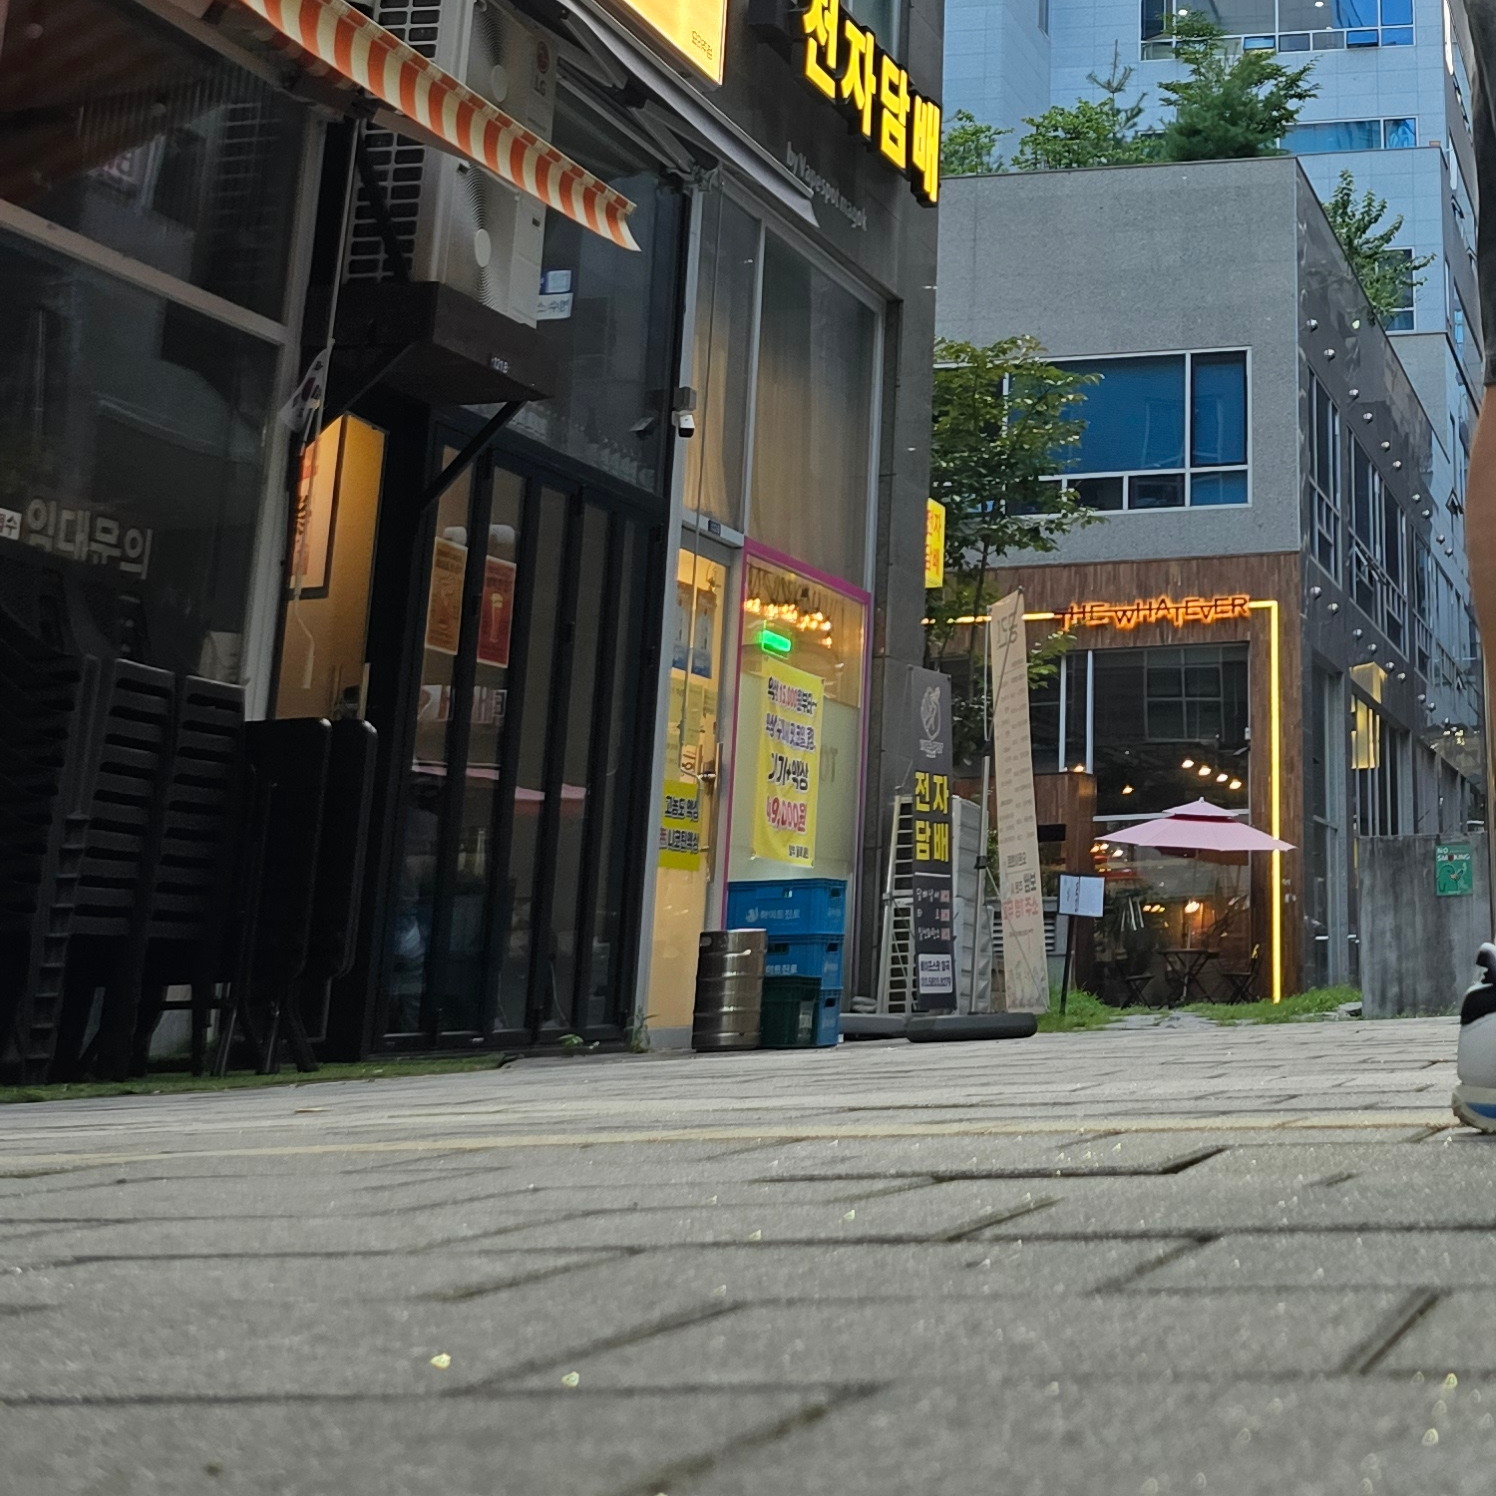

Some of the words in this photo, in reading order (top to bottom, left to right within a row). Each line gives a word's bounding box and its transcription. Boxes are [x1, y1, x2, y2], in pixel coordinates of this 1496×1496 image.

[1061, 603, 1105, 630] THE
[1113, 595, 1250, 630] WHATEVER
[665, 795, 685, 817] 고농도
[686, 798, 699, 820] 액상
[915, 770, 950, 815] 전자
[914, 820, 950, 863] 담배
